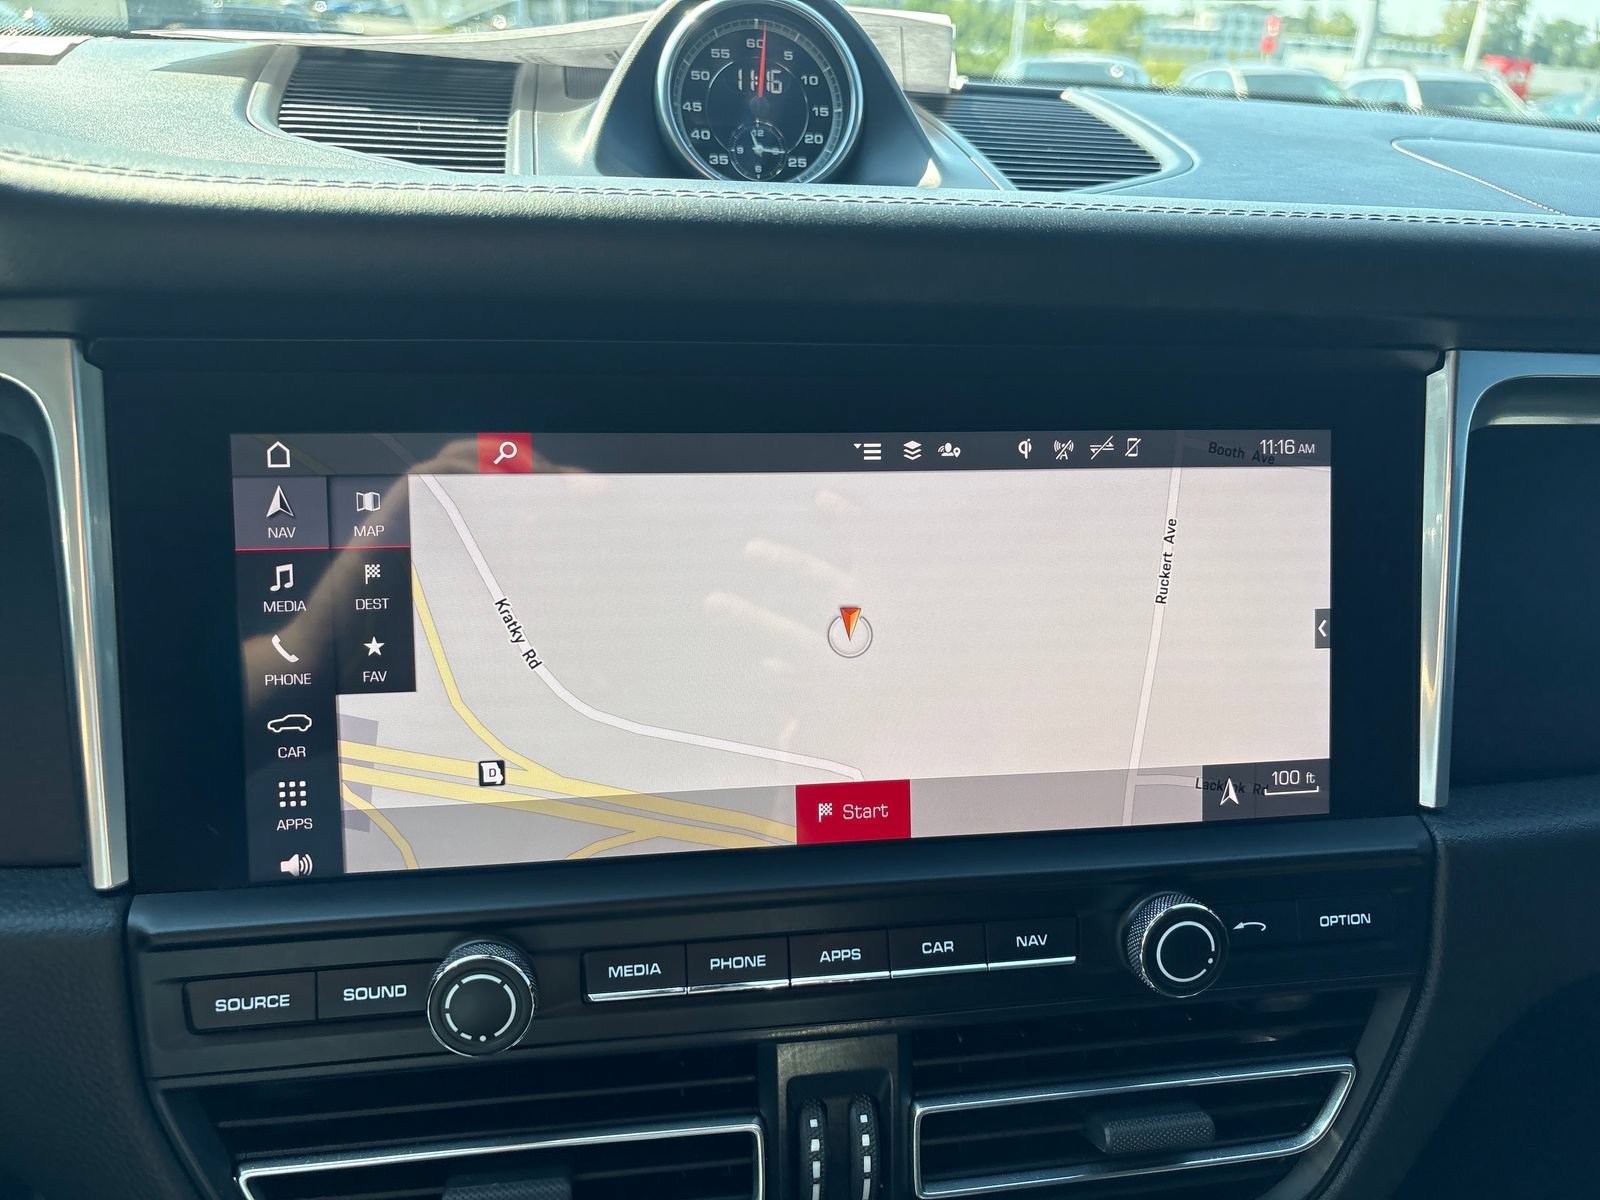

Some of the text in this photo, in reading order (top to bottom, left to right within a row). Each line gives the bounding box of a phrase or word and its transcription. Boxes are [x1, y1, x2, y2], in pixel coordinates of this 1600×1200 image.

[746, 38, 765, 49] 60
[711, 49, 730, 58] 55
[784, 51, 793, 60] 5
[691, 71, 710, 80] 50
[737, 69, 783, 94] 11:16
[801, 76, 818, 85] 10
[682, 102, 702, 112] 45
[812, 107, 829, 117] 15
[691, 130, 710, 140] 40
[751, 129, 764, 137] 12
[804, 134, 823, 144] 20
[709, 155, 729, 165] 35
[788, 158, 807, 168] 25
[754, 165, 762, 173] 6
[1208, 441, 1275, 465] Booth Ave
[1259, 439, 1315, 455] 11:16 AM
[267, 527, 296, 539] NAV
[353, 525, 385, 537] MAP
[1155, 518, 1177, 604] Ruckert Ave
[263, 600, 306, 613] MEDIA
[355, 598, 389, 610] DEST
[494, 598, 542, 671] Kratky Rd
[264, 673, 312, 686] PHONE
[362, 671, 387, 682] FAV
[277, 746, 306, 759] CAR
[488, 767, 497, 779] D
[1271, 770, 1316, 785] 100 ft
[1253, 784, 1268, 795] Rd
[842, 803, 889, 820] Start
[276, 818, 313, 831] APPS
[1319, 913, 1371, 928] OPTION
[1016, 934, 1048, 947] NAV
[922, 941, 954, 954] CAR
[820, 948, 861, 963] APPS
[710, 955, 766, 970] PHONE
[608, 963, 662, 978] MEDIA
[343, 984, 407, 1001] SOUND
[215, 994, 290, 1012] SOURCE
